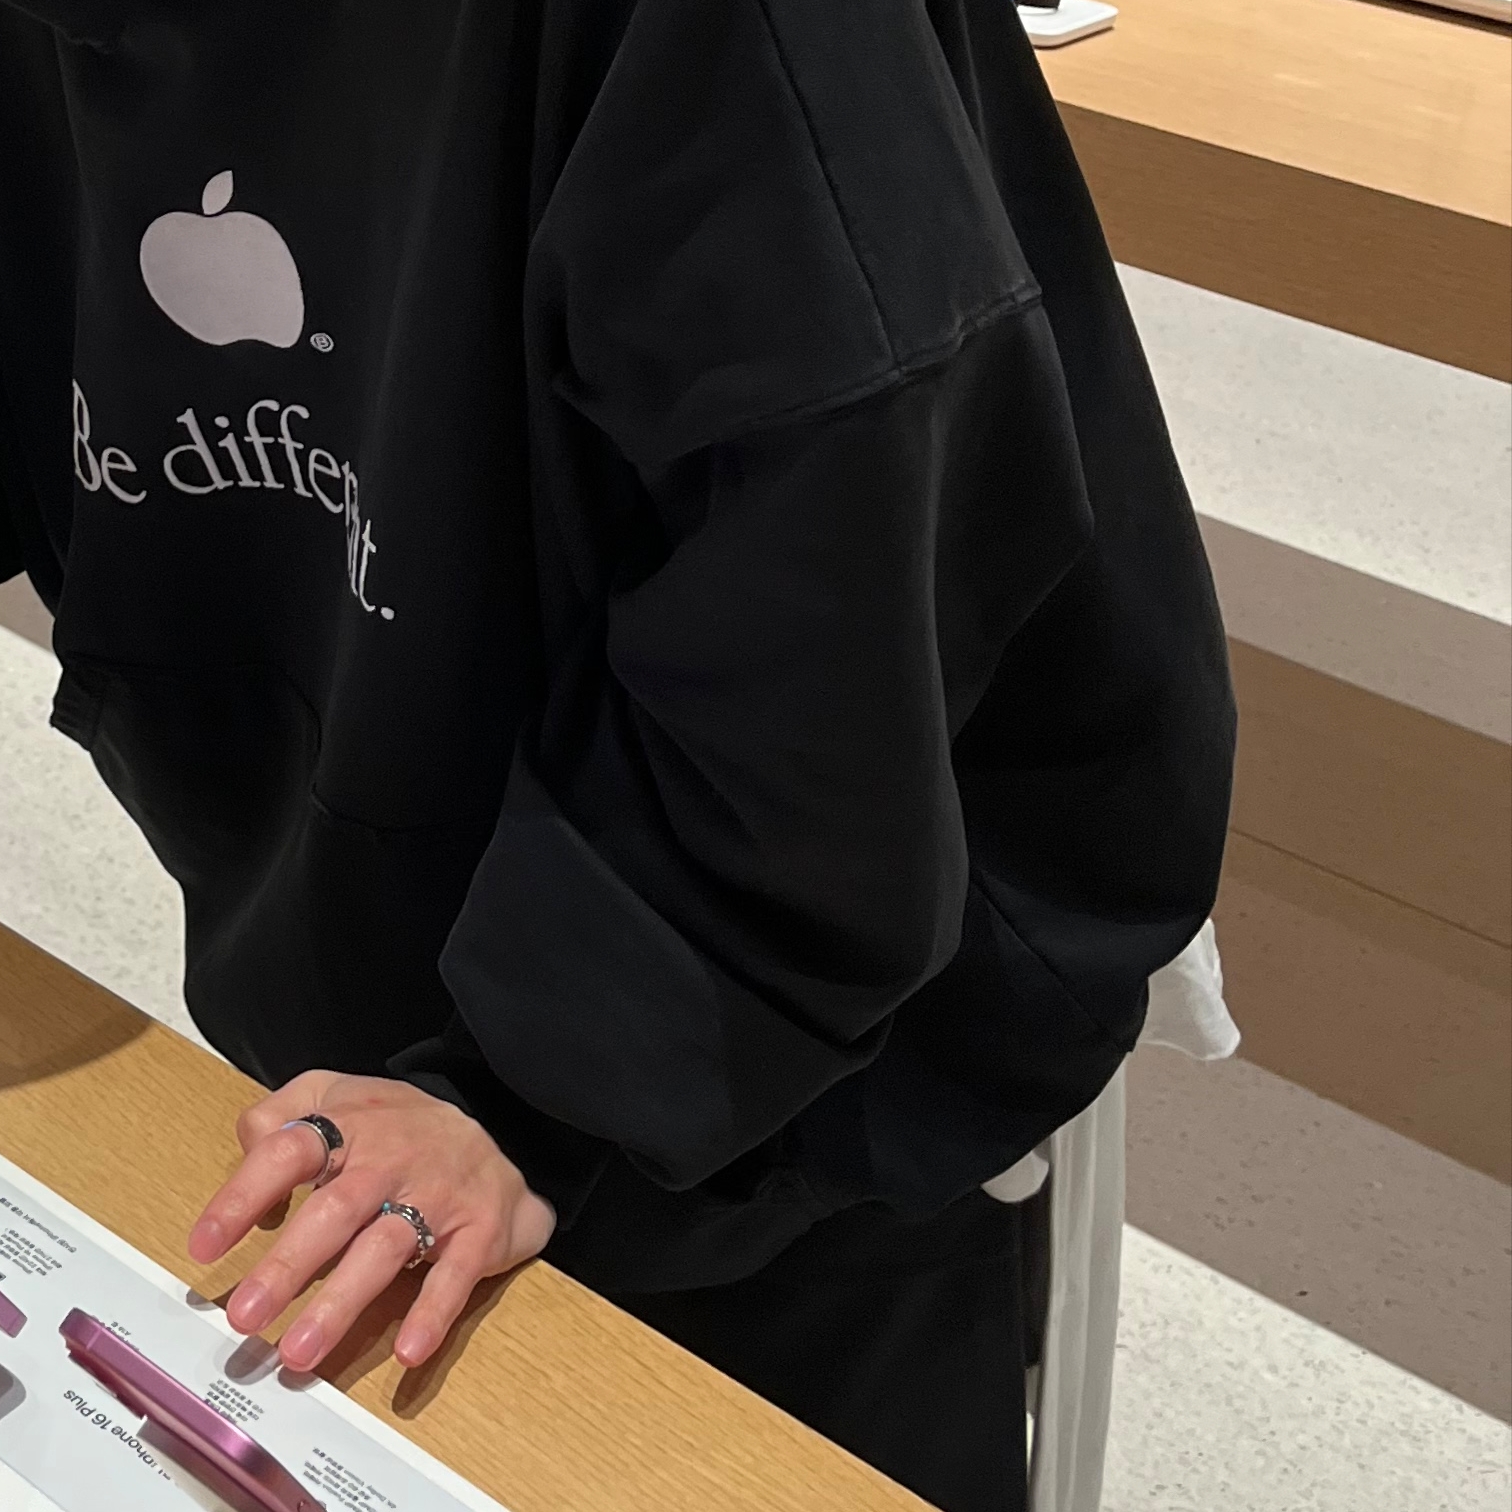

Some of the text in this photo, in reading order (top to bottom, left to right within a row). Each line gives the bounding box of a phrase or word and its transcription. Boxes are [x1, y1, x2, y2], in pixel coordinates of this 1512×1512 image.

[72, 379, 148, 505] Be
[63, 1389, 97, 1417] Plus
[91, 1413, 112, 1430] 16
